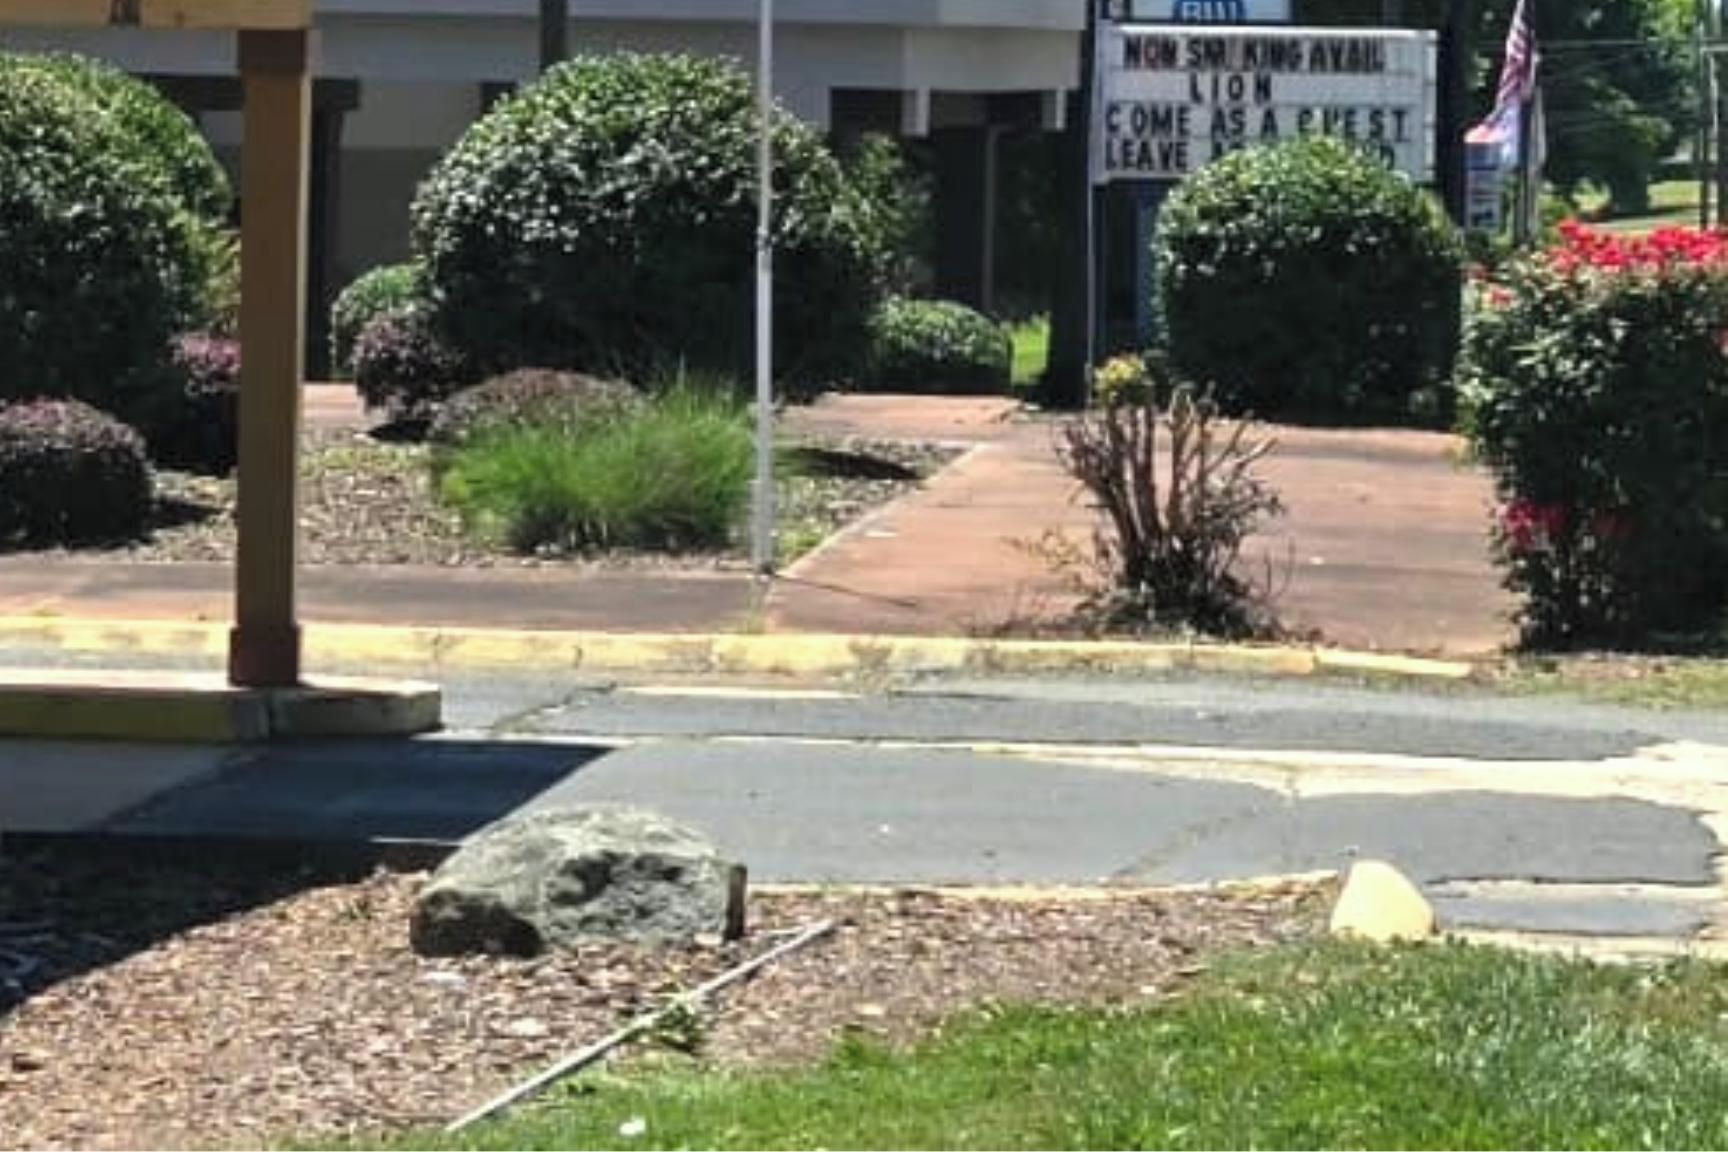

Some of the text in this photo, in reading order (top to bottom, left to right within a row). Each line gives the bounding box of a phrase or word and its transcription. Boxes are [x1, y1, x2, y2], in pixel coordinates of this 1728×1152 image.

[1123, 35, 1177, 70] NON
[1309, 36, 1385, 72] AVAIL
[1189, 73, 1272, 103] LION
[1105, 103, 1190, 136] COME
[1211, 107, 1245, 138] AS
[1261, 108, 1278, 139] A
[1105, 138, 1188, 172] LEAVE
